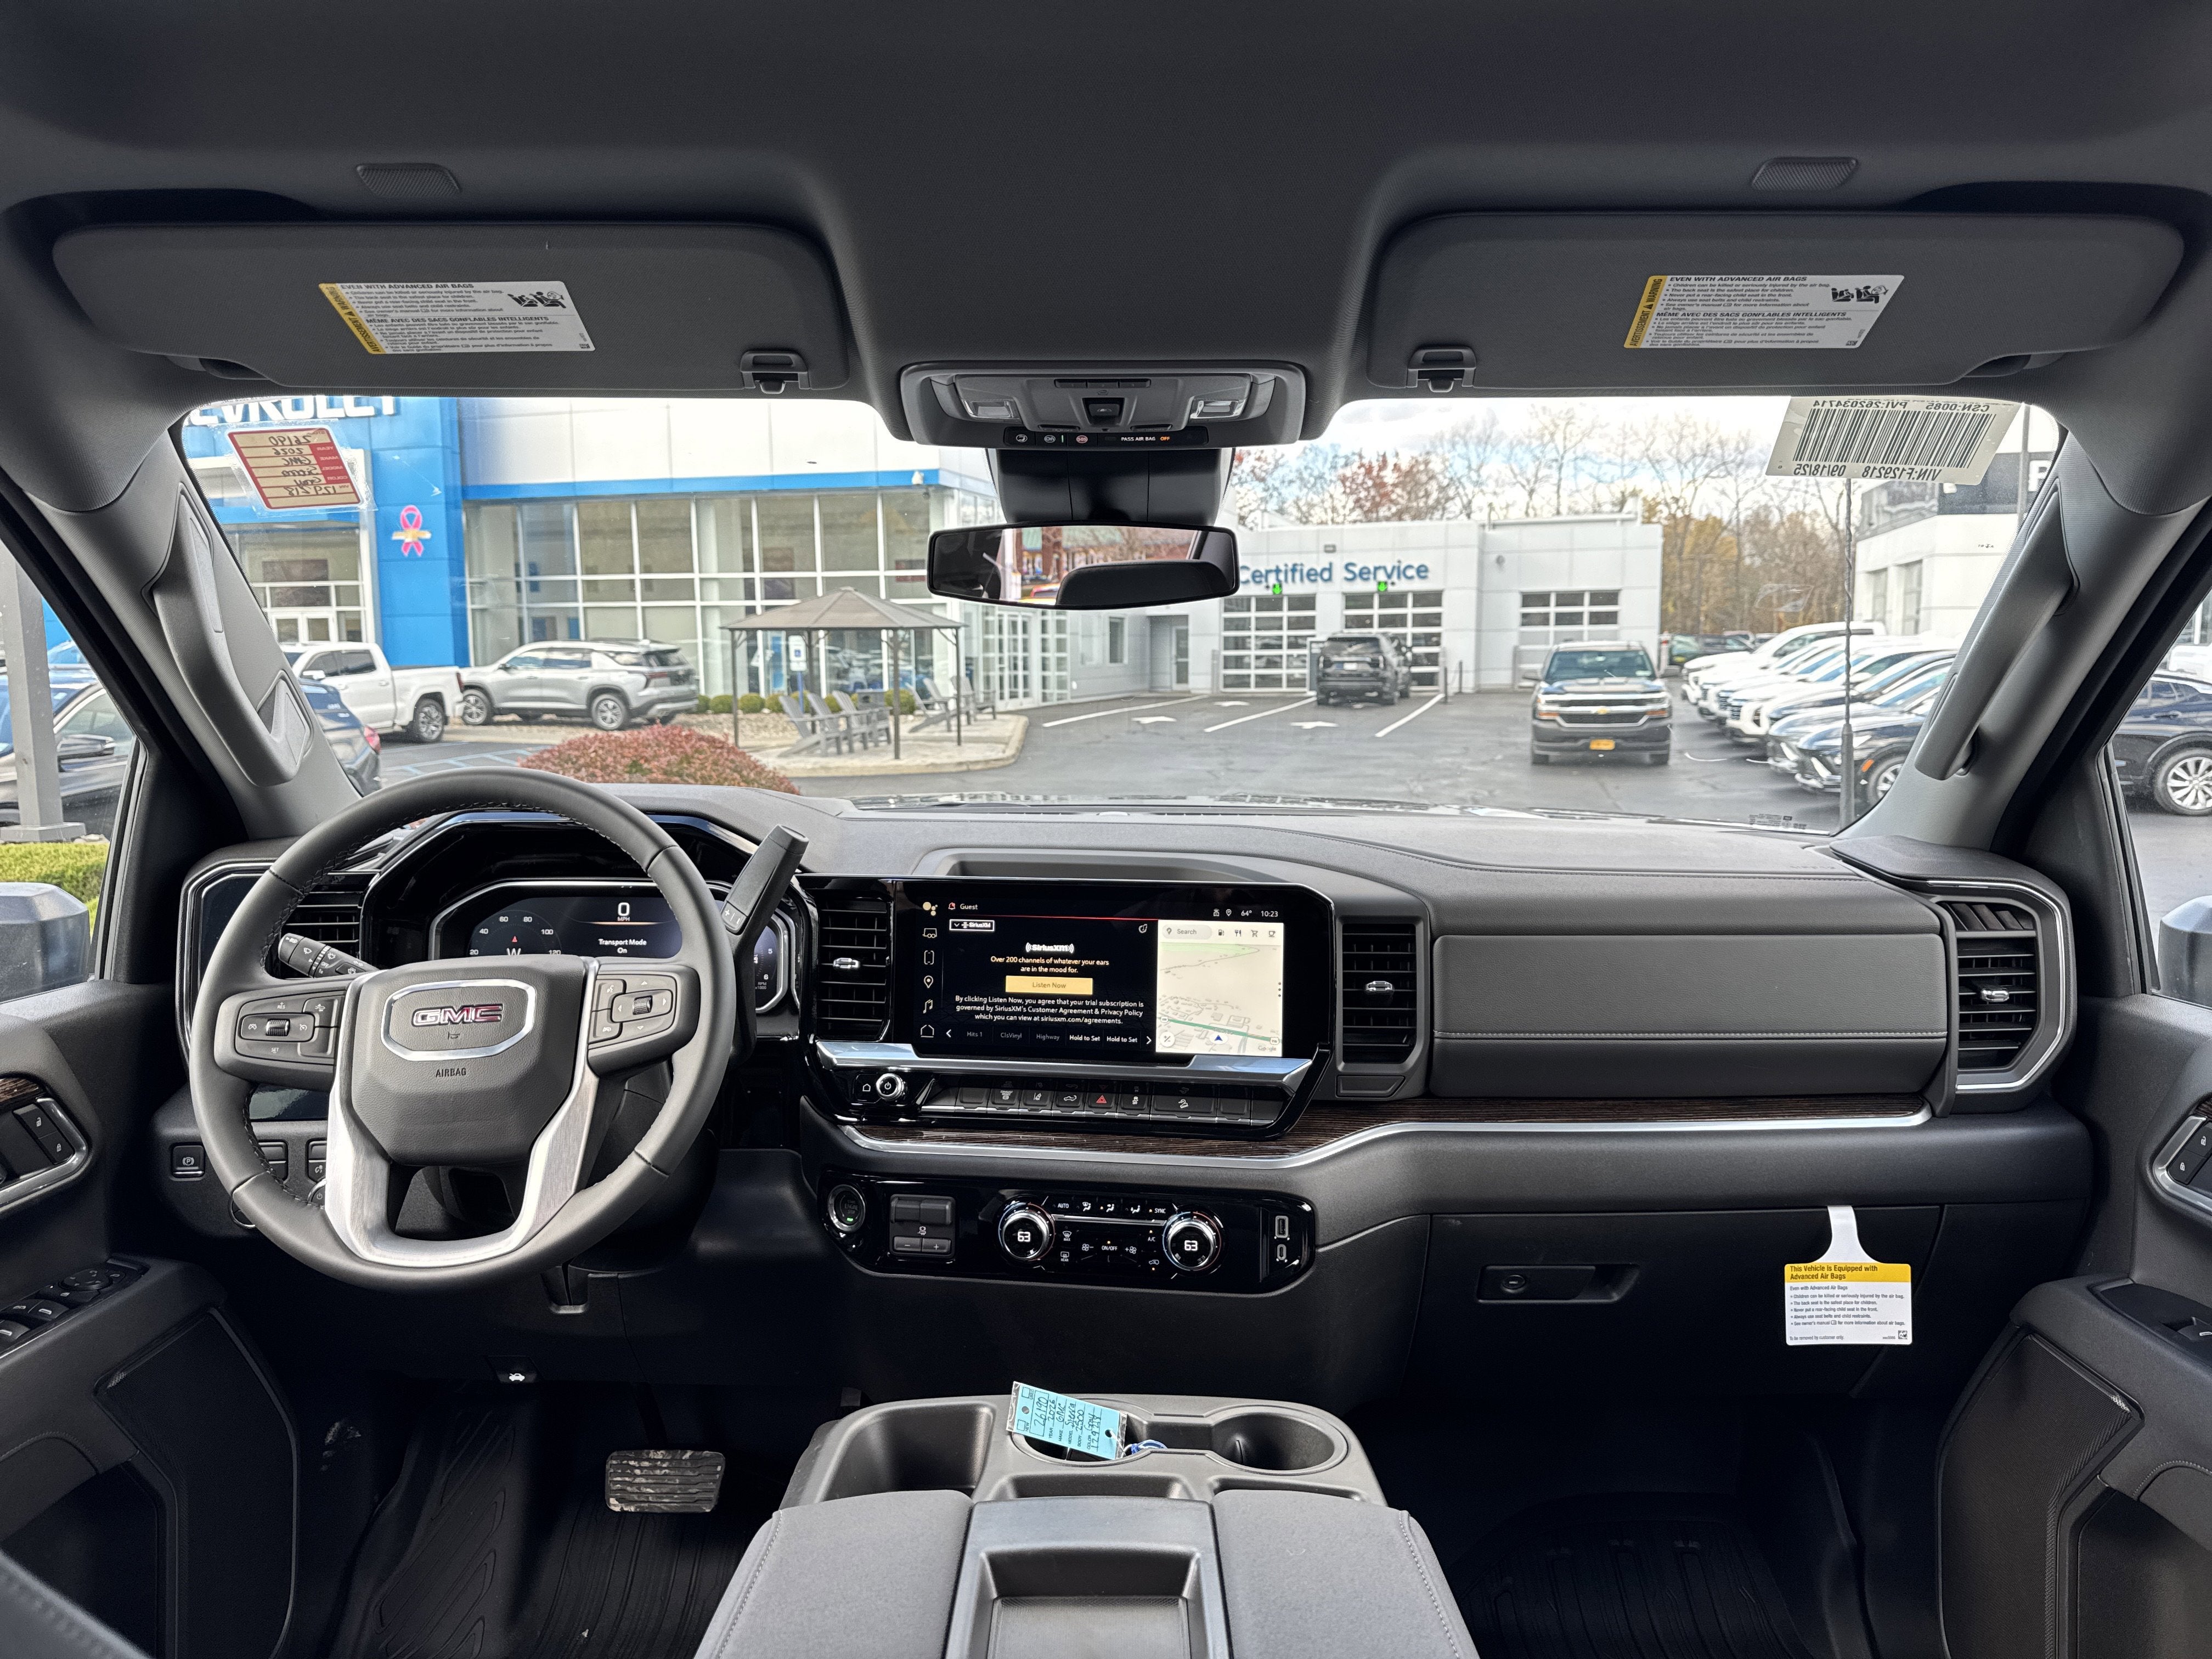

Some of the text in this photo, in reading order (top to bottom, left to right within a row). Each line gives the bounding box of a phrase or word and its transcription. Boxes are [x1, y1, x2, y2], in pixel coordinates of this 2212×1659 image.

[1646, 279, 1662, 302] WARNING
[1629, 310, 1651, 346] AVERTISSEMENT
[1240, 559, 1429, 584] Certified Service
[618, 902, 629, 916] 0
[964, 995, 987, 1003] clicking
[1099, 1000, 1136, 1008] subscription
[413, 1003, 503, 1026] GMC
[986, 1005, 993, 1014] by
[1101, 1008, 1122, 1017] Privacy
[1041, 1015, 1122, 1025] siriusxm.com/agreements.
[436, 1067, 466, 1077] AIRBAG
[1018, 1231, 1030, 1242] 63
[1184, 1240, 1197, 1250] 63
[1034, 1397, 1048, 1426] 26190
[1057, 1403, 1065, 1422] GMC
[1076, 1409, 1084, 1431] 2500
